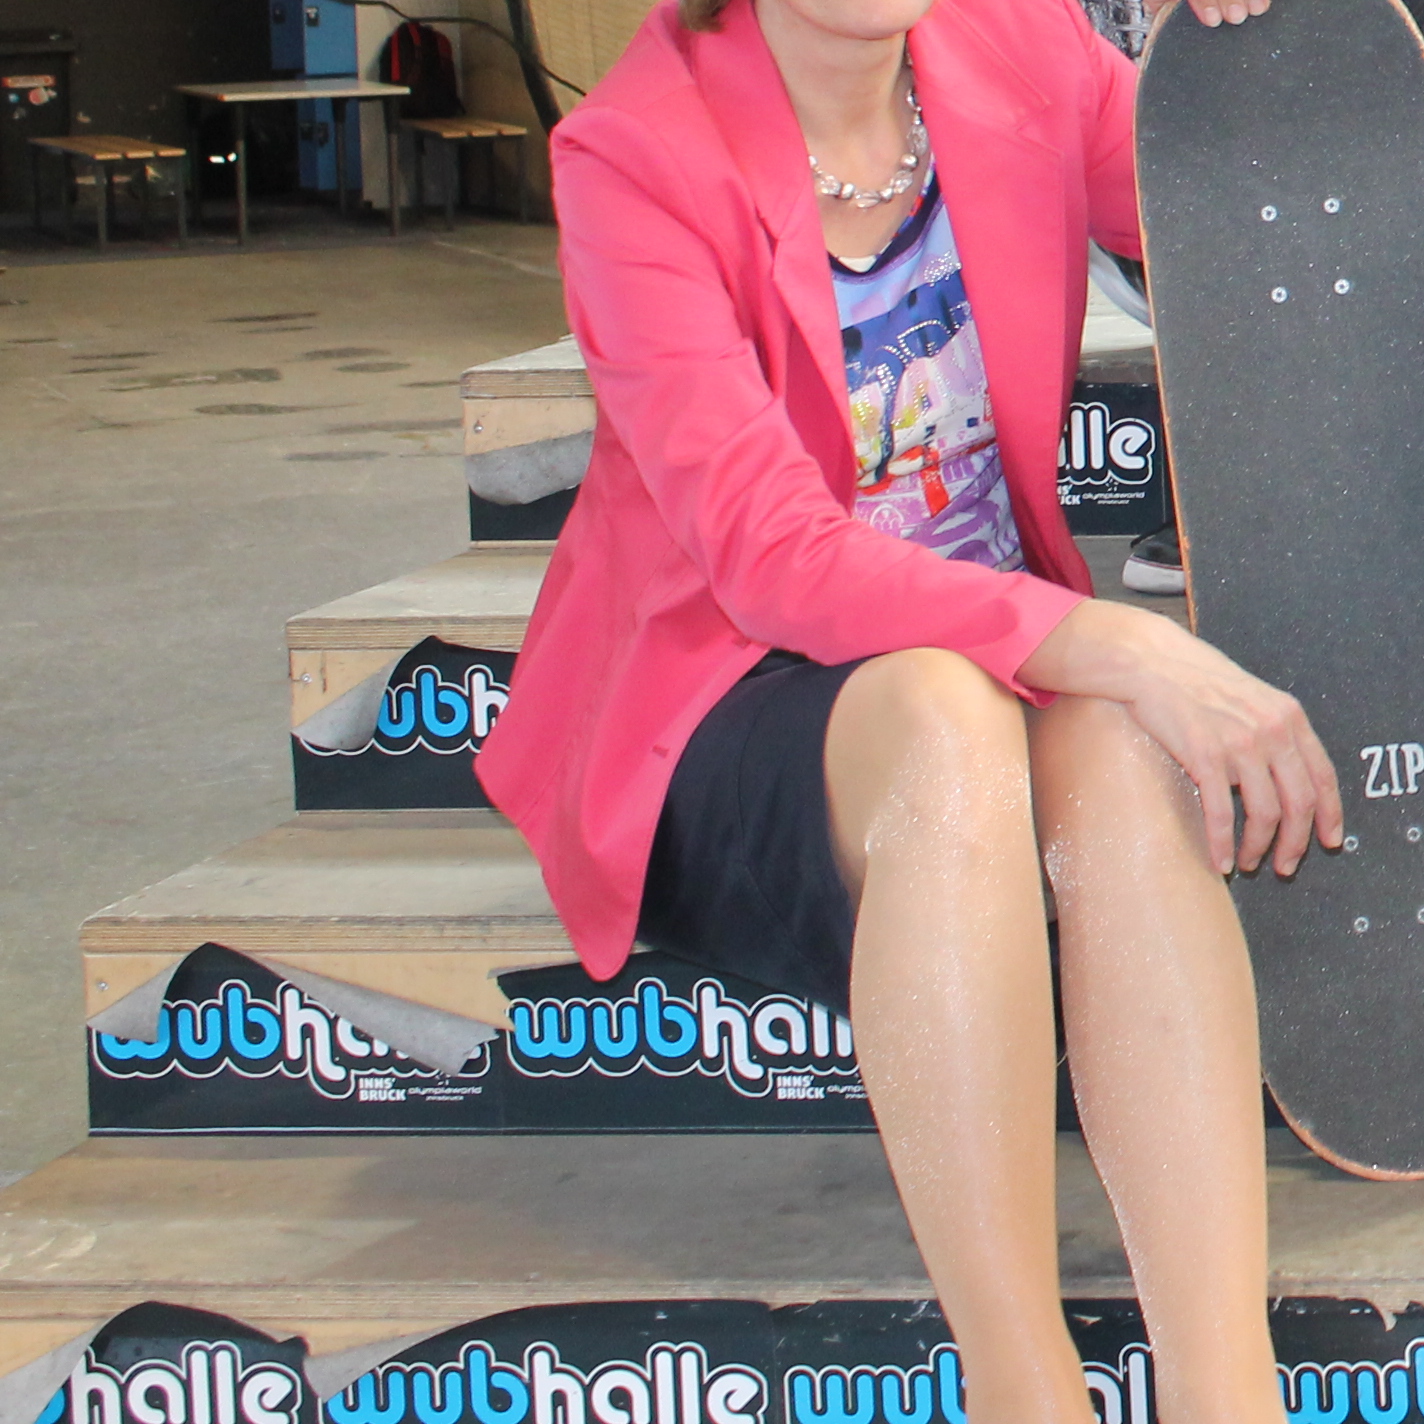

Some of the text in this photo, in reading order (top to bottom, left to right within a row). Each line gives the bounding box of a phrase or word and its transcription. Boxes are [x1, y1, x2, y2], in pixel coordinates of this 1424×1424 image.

[514, 985, 853, 1080] wubhall
[359, 1088, 406, 1102] BRUCK
[776, 1087, 826, 1100] BRUCK
[36, 1348, 294, 1424] halle
